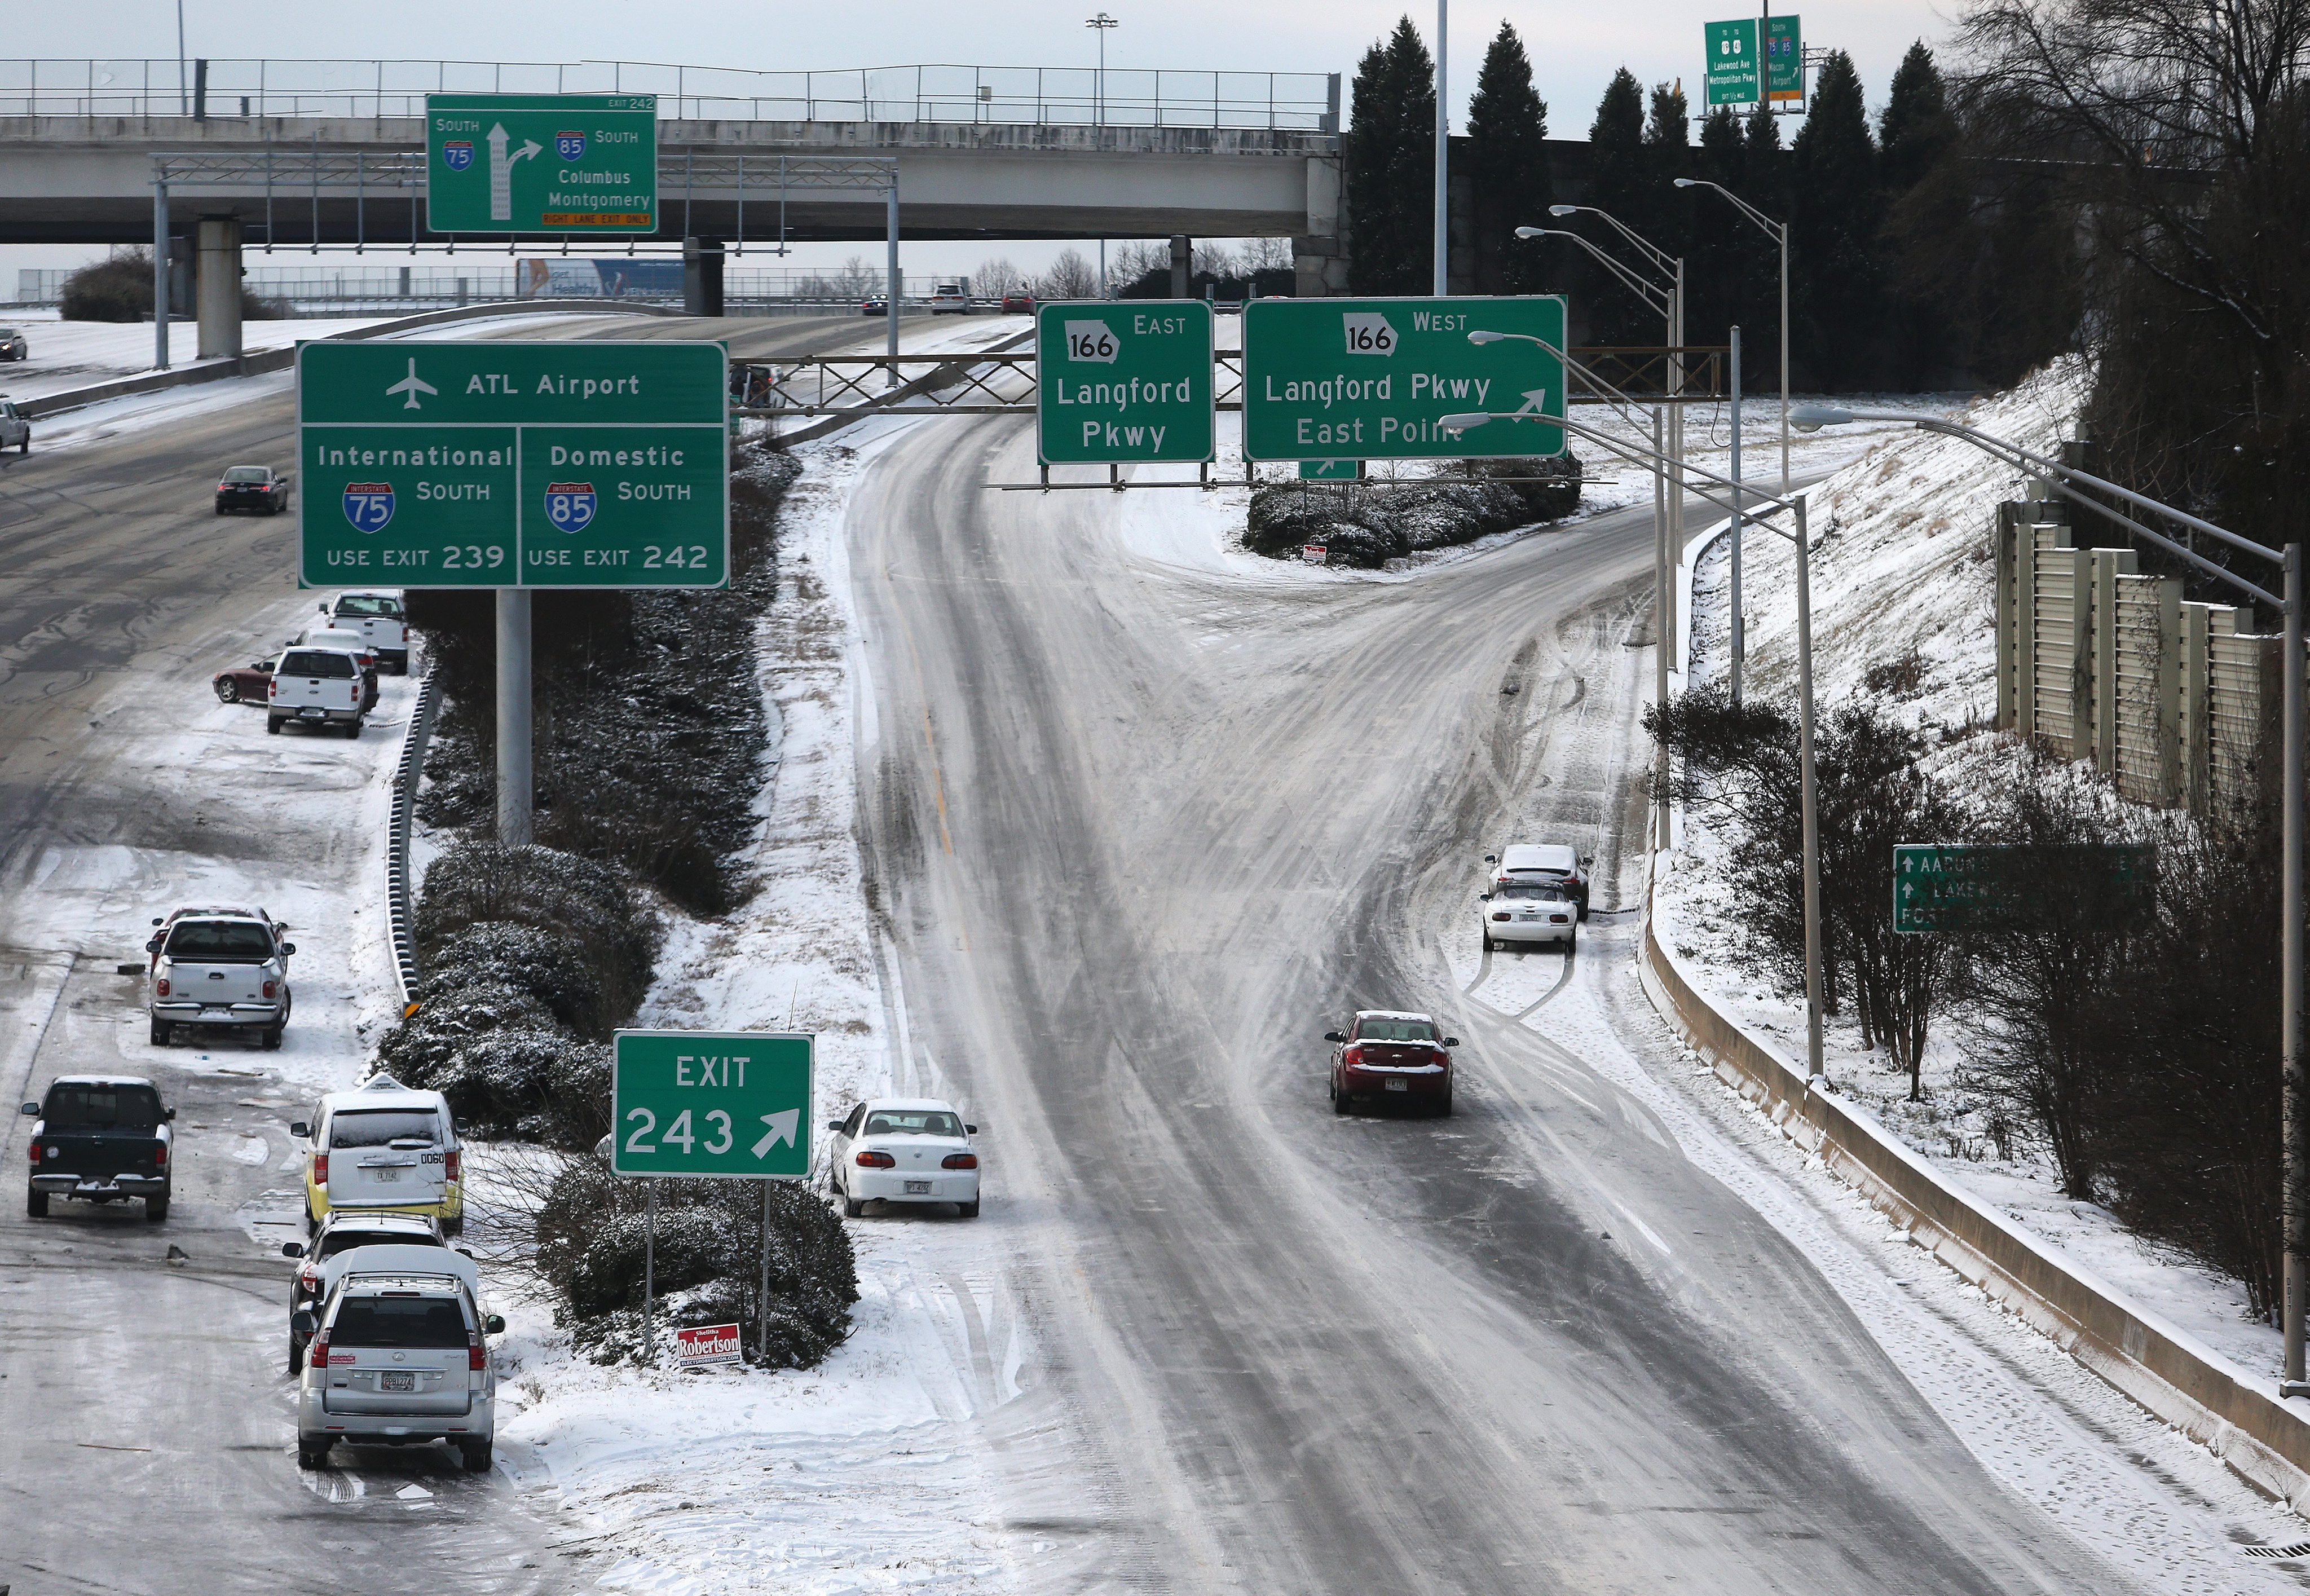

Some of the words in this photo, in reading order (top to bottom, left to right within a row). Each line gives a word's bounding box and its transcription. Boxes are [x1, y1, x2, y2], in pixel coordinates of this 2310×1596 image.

[1714, 61, 1739, 71] Lakewood
[629, 98, 653, 109] 242
[435, 118, 479, 132] SOUTH
[559, 139, 581, 154] 85
[595, 130, 638, 143] SOUTH
[448, 149, 469, 164] 75
[559, 170, 631, 184] Columbus
[548, 192, 650, 210] Montgomery
[574, 214, 596, 223] LANE
[602, 214, 620, 223] EXIT
[1134, 315, 1186, 334] EAST
[1413, 311, 1467, 332] WEST
[1071, 333, 1113, 358] 166
[1349, 326, 1391, 350] 166
[465, 374, 518, 394] ATL
[536, 374, 640, 399] Airport
[1058, 377, 1190, 412] Langford
[1266, 374, 1391, 409] Langford
[1412, 373, 1490, 405] Pkwy
[1083, 421, 1166, 453] Pkwy
[1297, 417, 1364, 444] East
[319, 446, 512, 466] International
[550, 446, 684, 466] Domestic
[416, 481, 491, 501] SOUTH
[617, 482, 691, 501] SOUTH
[349, 496, 389, 524] 75
[552, 495, 591, 524] 85
[327, 550, 371, 566] USE
[383, 550, 430, 566] EXIT
[442, 545, 505, 569] 239
[528, 550, 572, 566] USE
[584, 550, 631, 566] EXIT
[642, 545, 708, 569] 242
[677, 1056, 750, 1087] EXIT
[625, 1107, 733, 1154] 243
[678, 1335, 739, 1357] Robertson
[681, 1356, 739, 1366] ELECTSROBERTSON.COM
